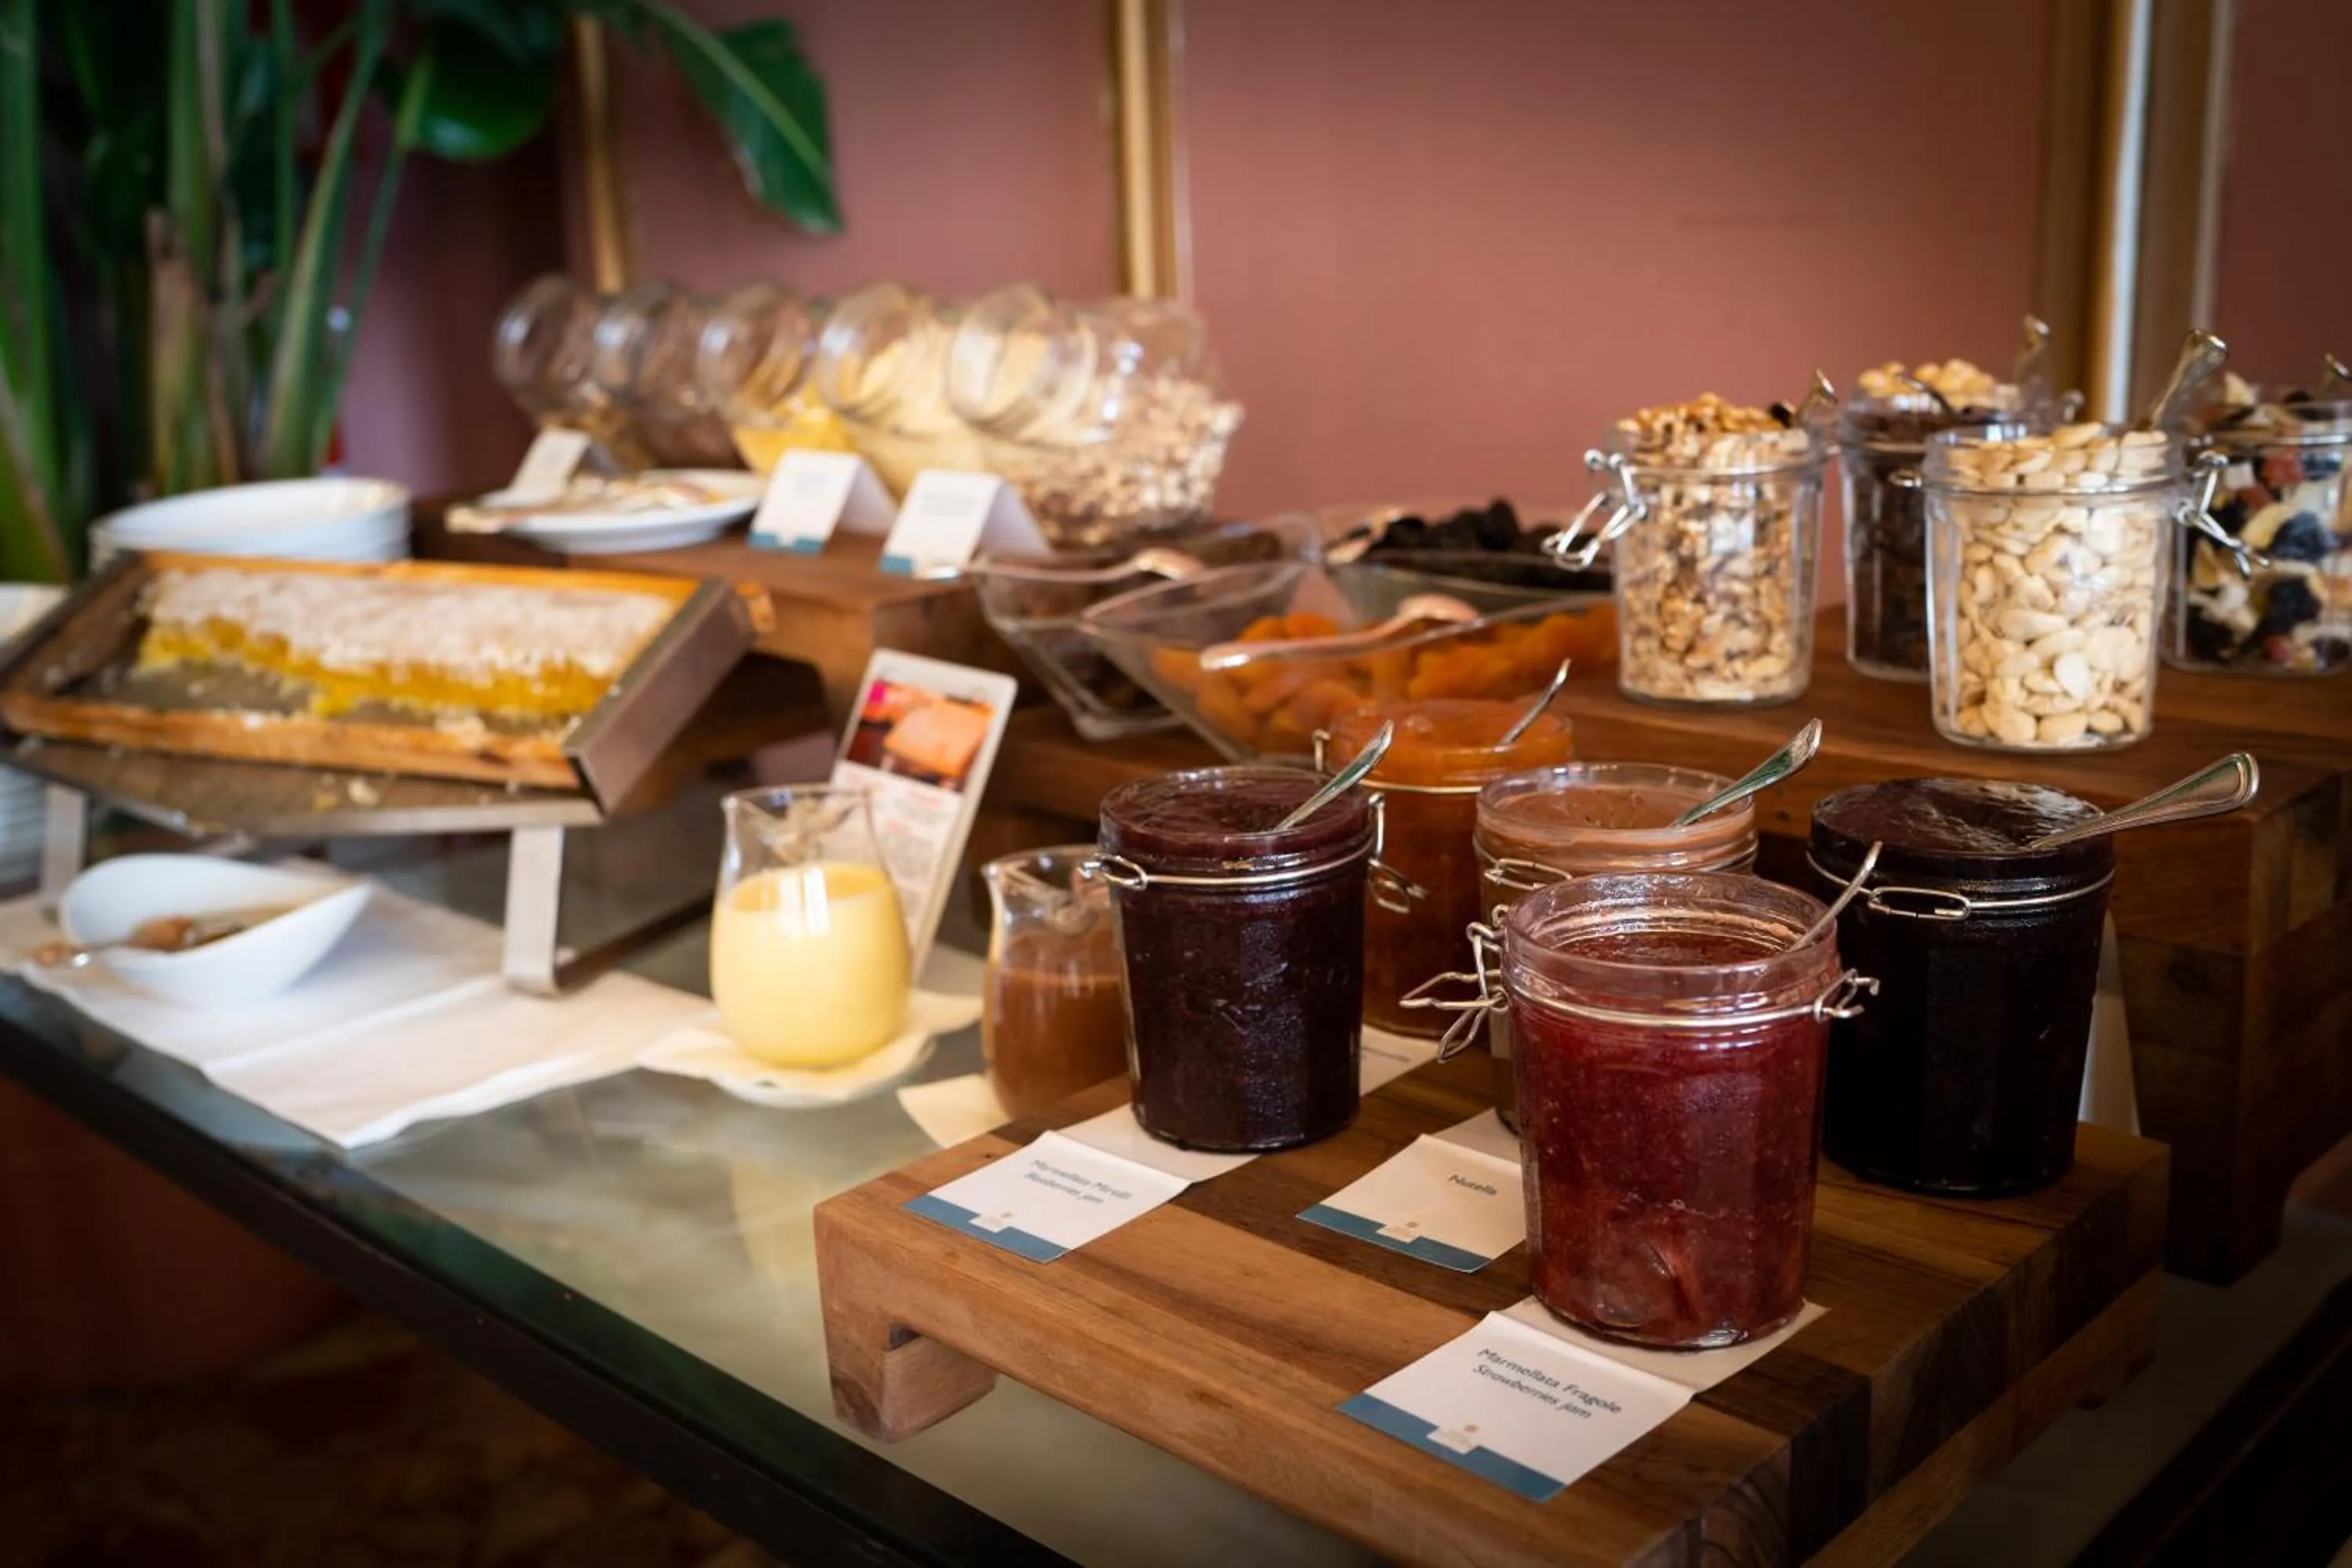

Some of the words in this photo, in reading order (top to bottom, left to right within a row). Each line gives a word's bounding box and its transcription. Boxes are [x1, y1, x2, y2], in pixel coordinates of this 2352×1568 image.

[1447, 1174, 1497, 1196] Nutella
[1477, 1347, 1561, 1388] Marmellata
[1563, 1383, 1622, 1414] Fragole
[1554, 1401, 1592, 1419] jam
